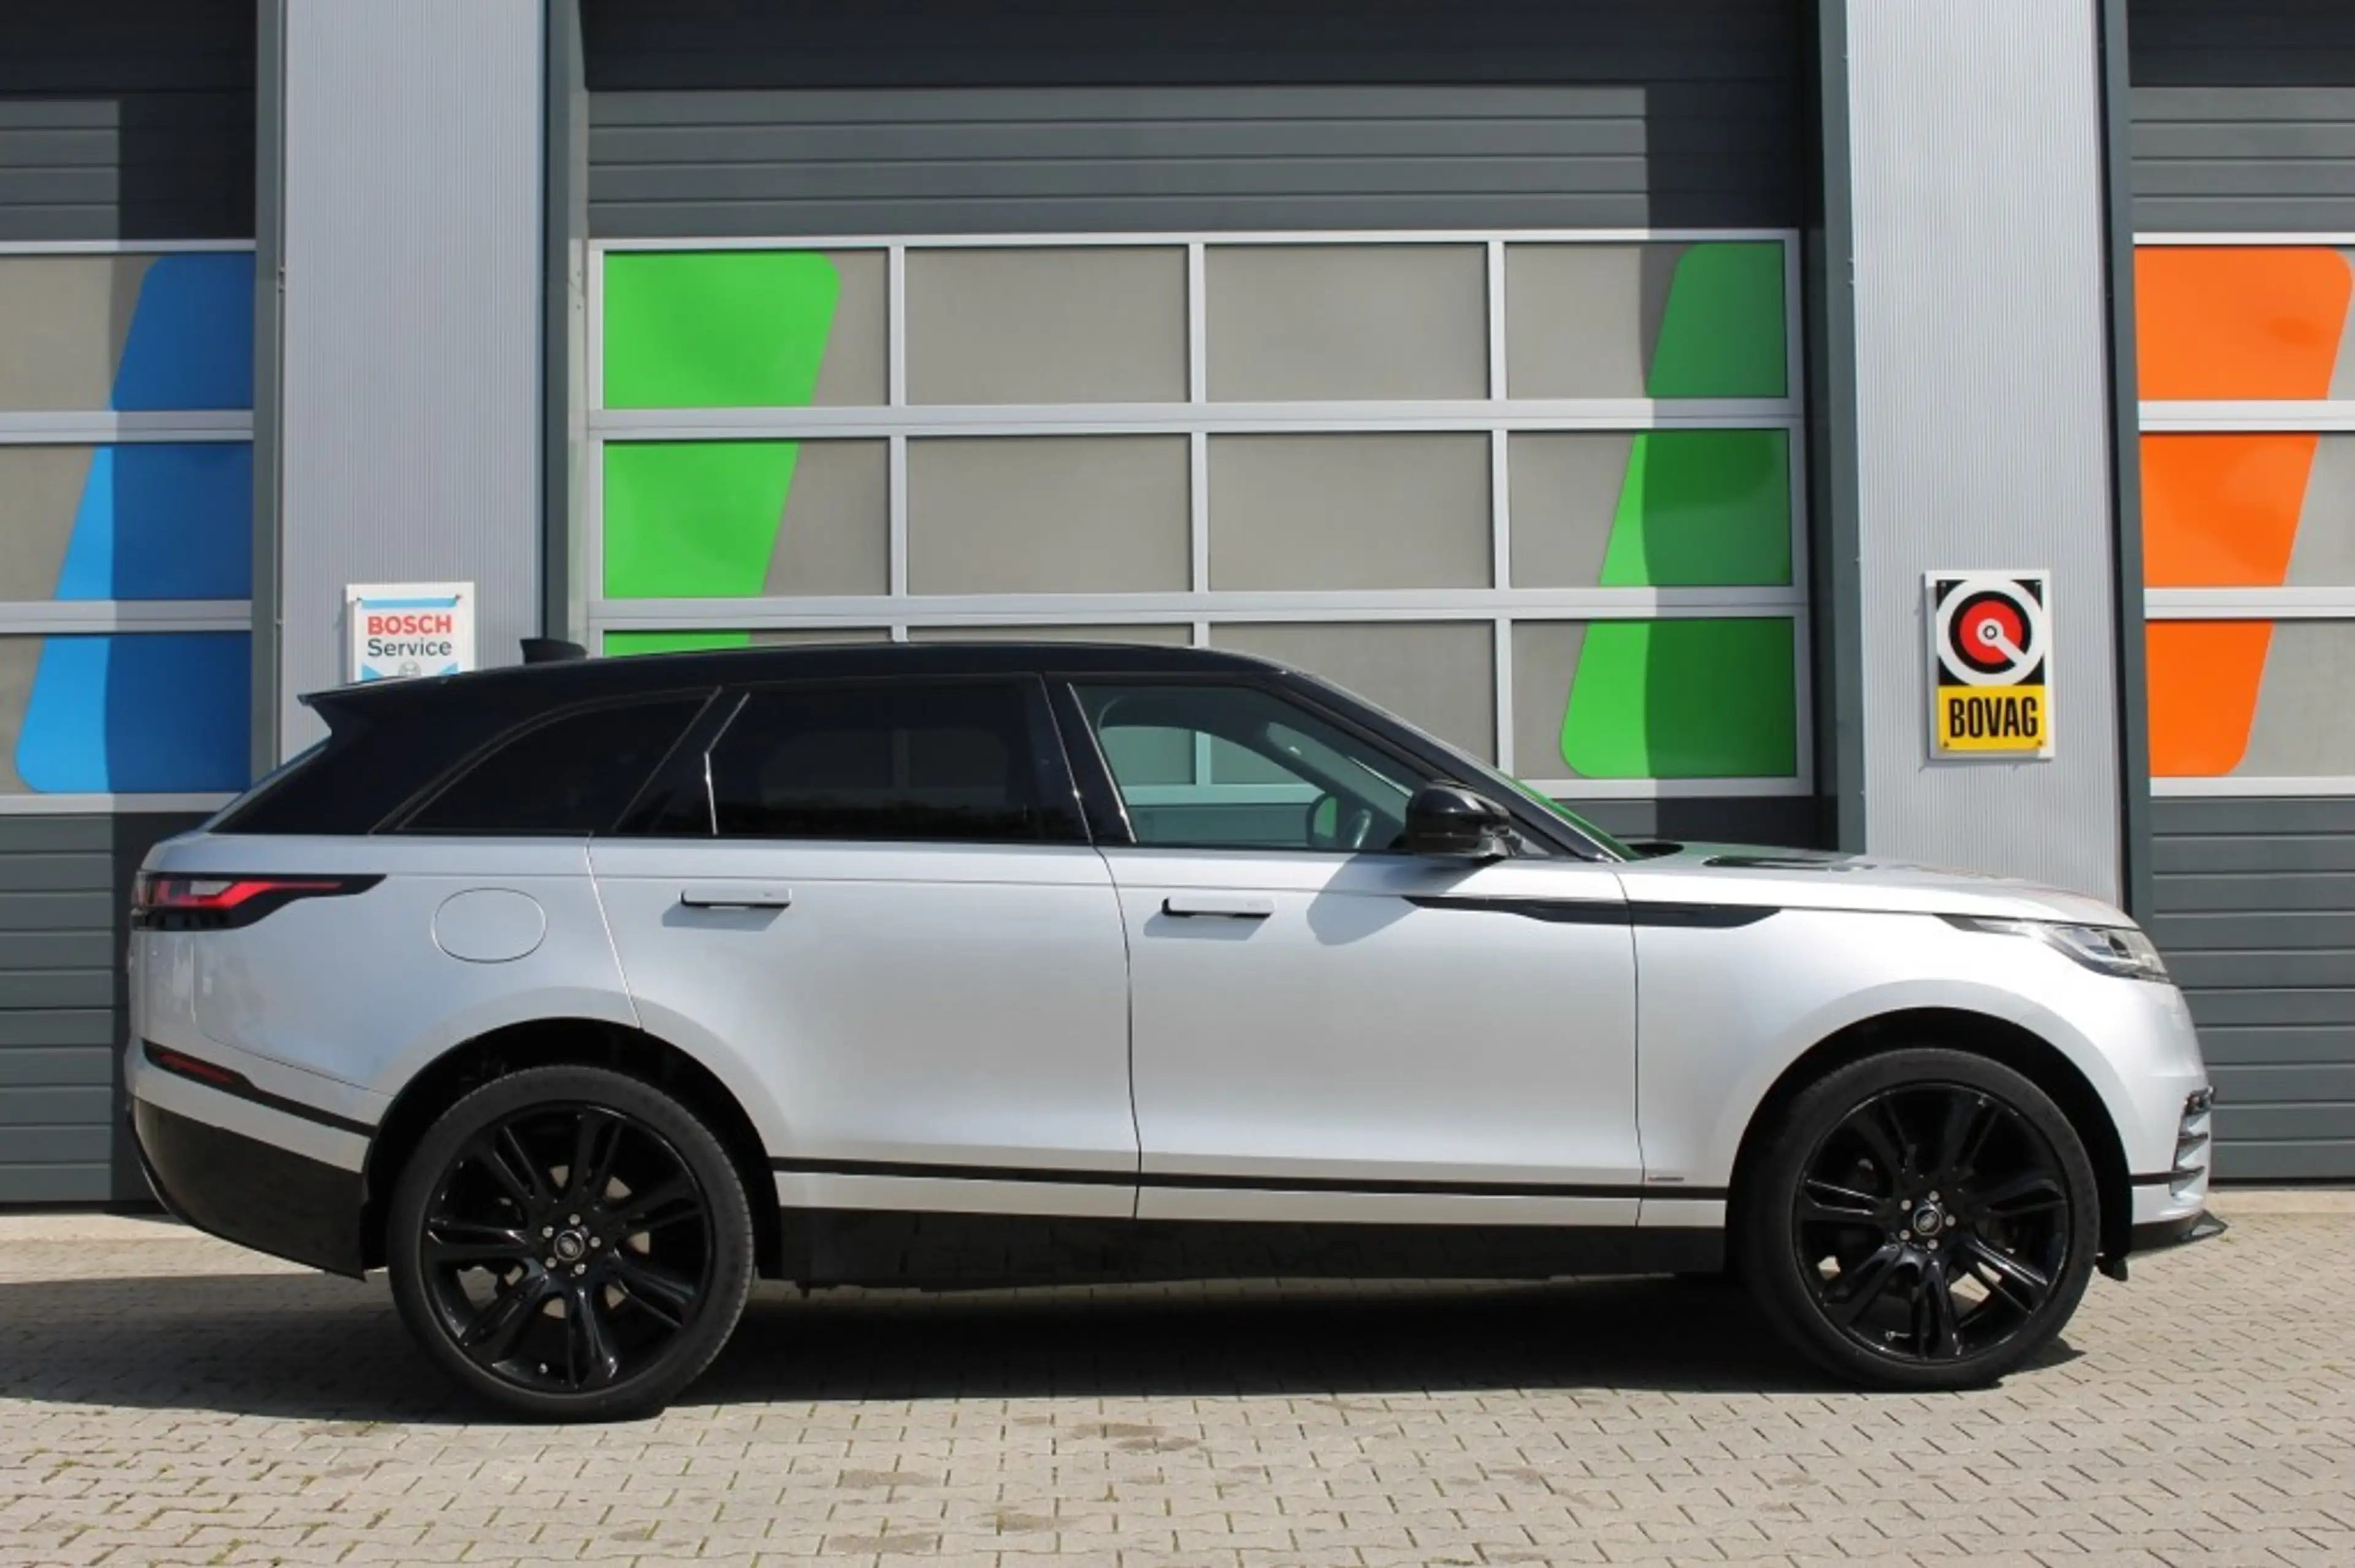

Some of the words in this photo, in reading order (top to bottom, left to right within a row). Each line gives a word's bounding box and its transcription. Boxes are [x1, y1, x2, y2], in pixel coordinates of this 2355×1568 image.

[368, 614, 451, 635] BOSCH
[367, 637, 452, 657] Service
[1949, 697, 2038, 738] BOVAG
